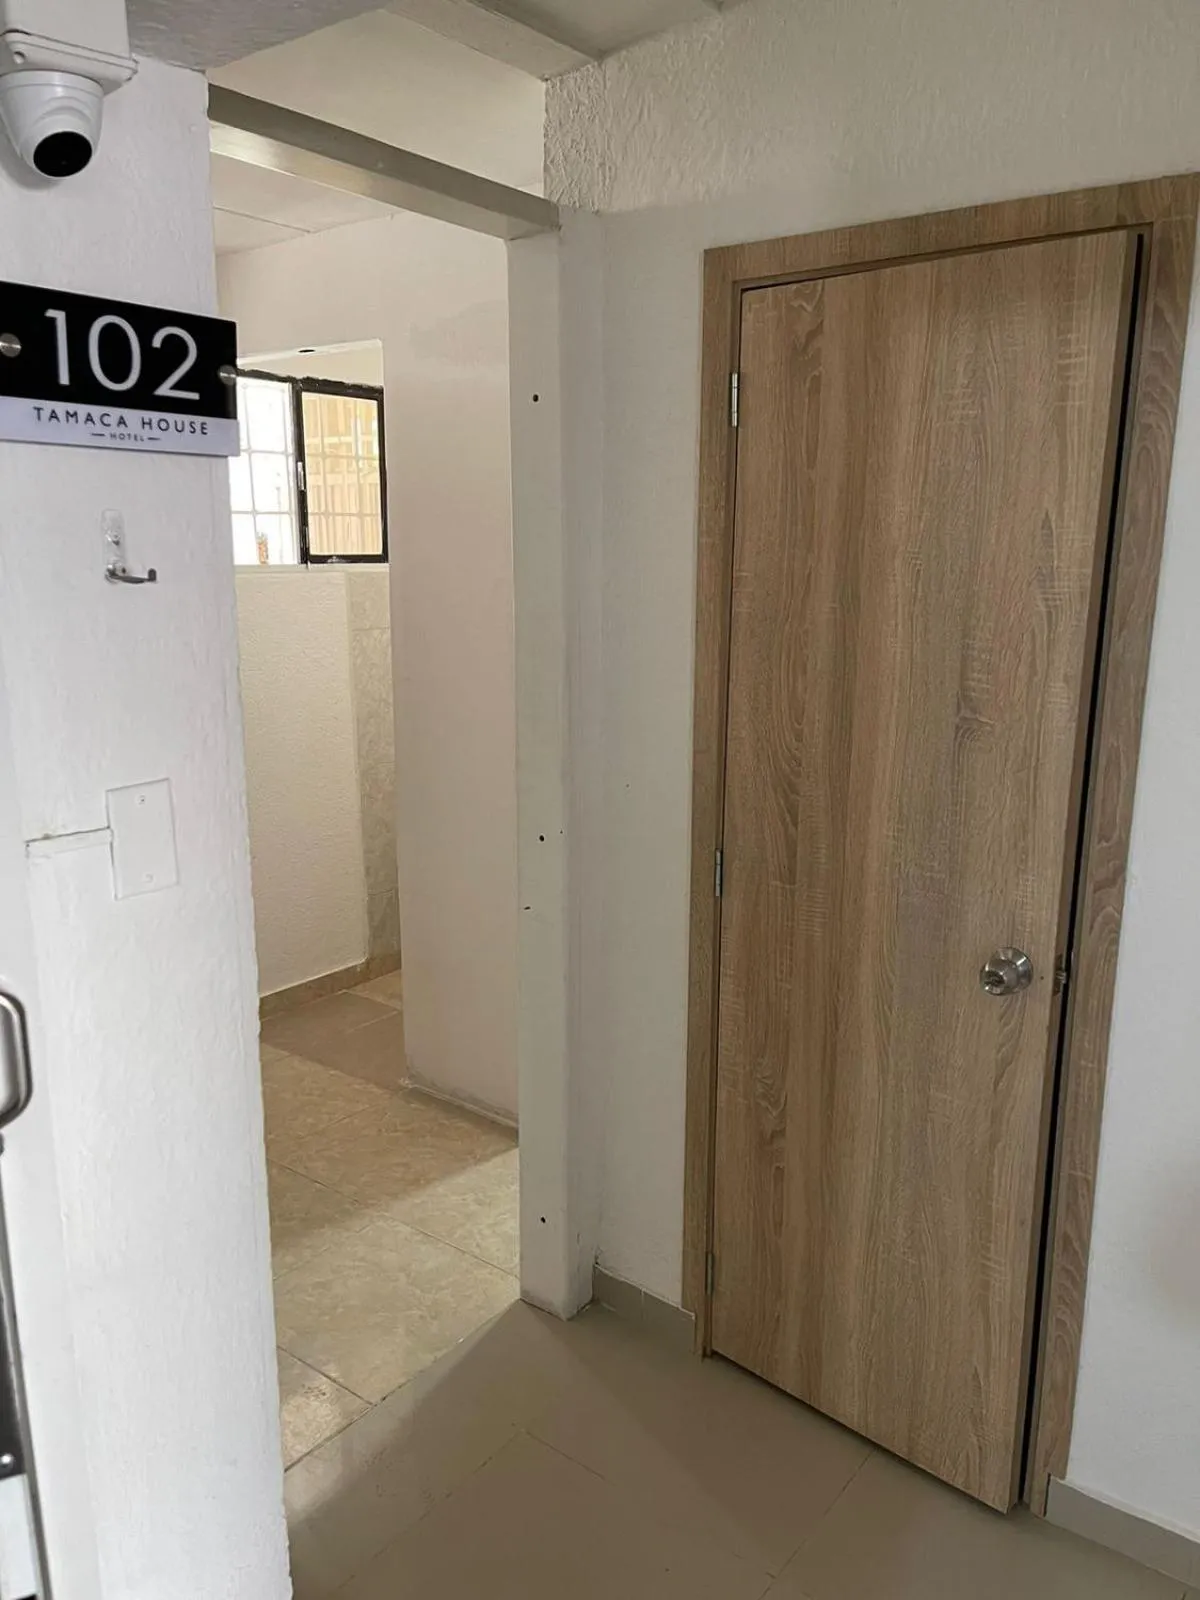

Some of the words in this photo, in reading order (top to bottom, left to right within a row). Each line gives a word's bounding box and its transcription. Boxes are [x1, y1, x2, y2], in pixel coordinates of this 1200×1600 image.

[44, 308, 200, 400] 102
[33, 406, 128, 428] TAMACA
[141, 417, 209, 435] HOUSE
[109, 432, 145, 442] HOTEL
